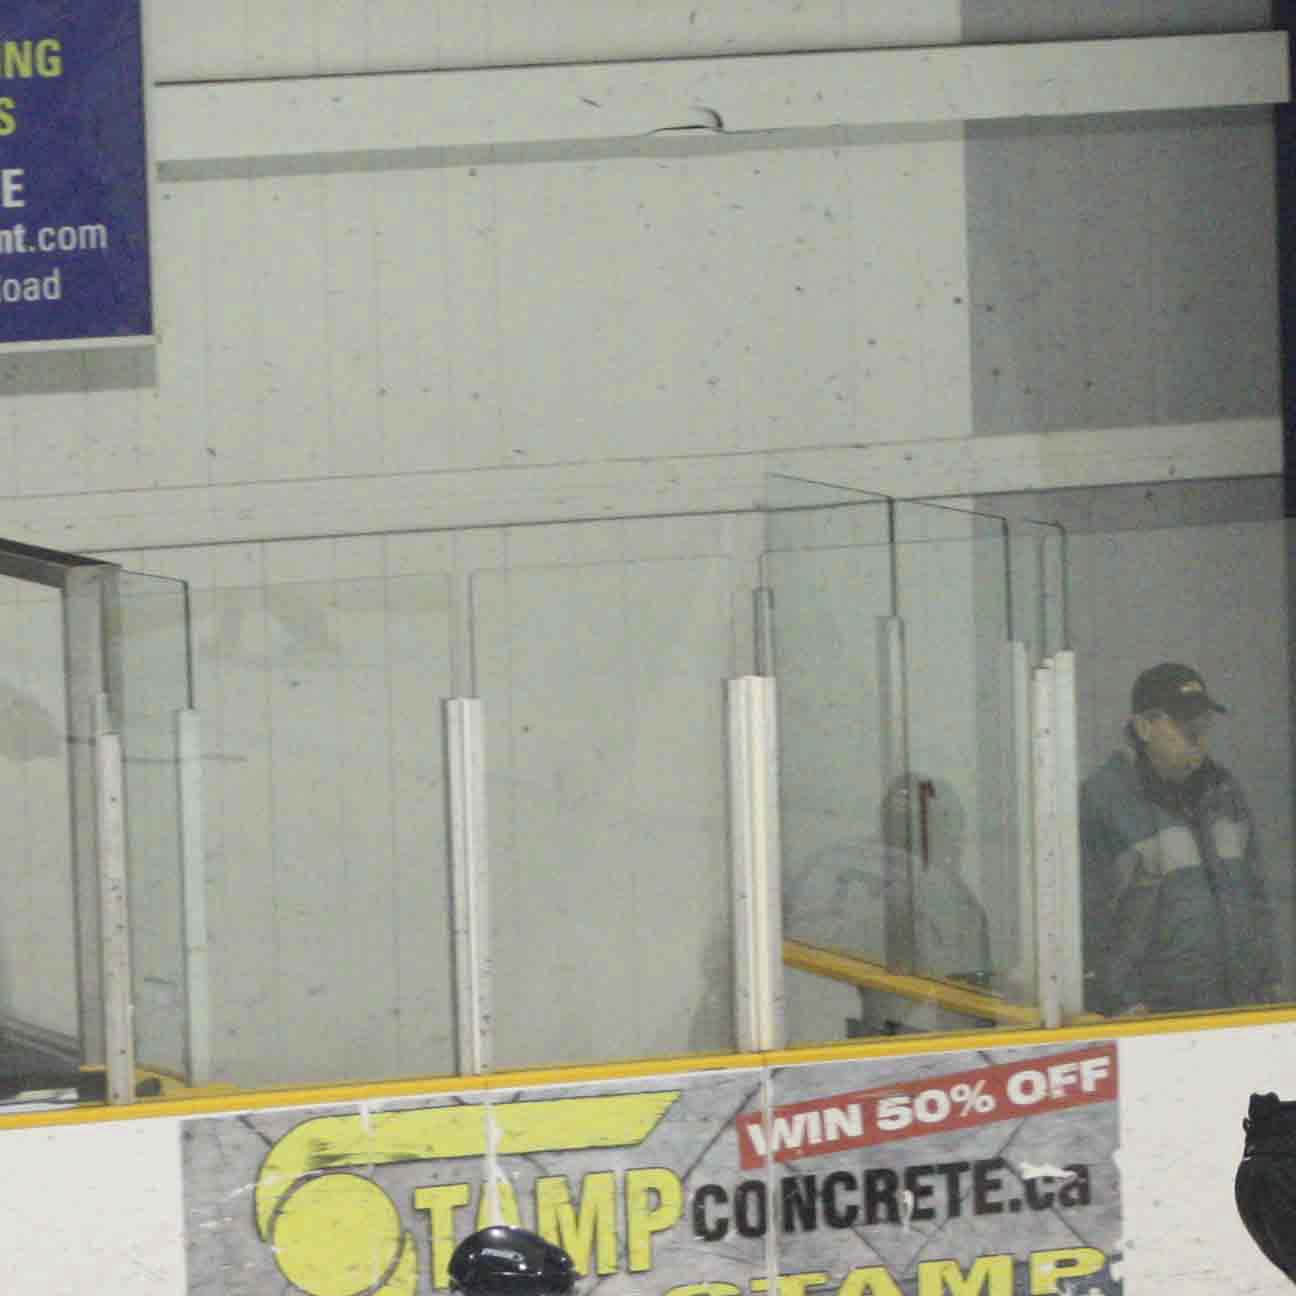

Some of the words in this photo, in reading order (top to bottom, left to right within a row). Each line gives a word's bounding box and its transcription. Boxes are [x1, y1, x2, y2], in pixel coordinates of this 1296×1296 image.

[747, 1103, 863, 1157] WIN
[876, 1079, 995, 1134] 50%
[1005, 1056, 1111, 1105] OFF
[692, 1157, 1092, 1243] CONCRETE.ca
